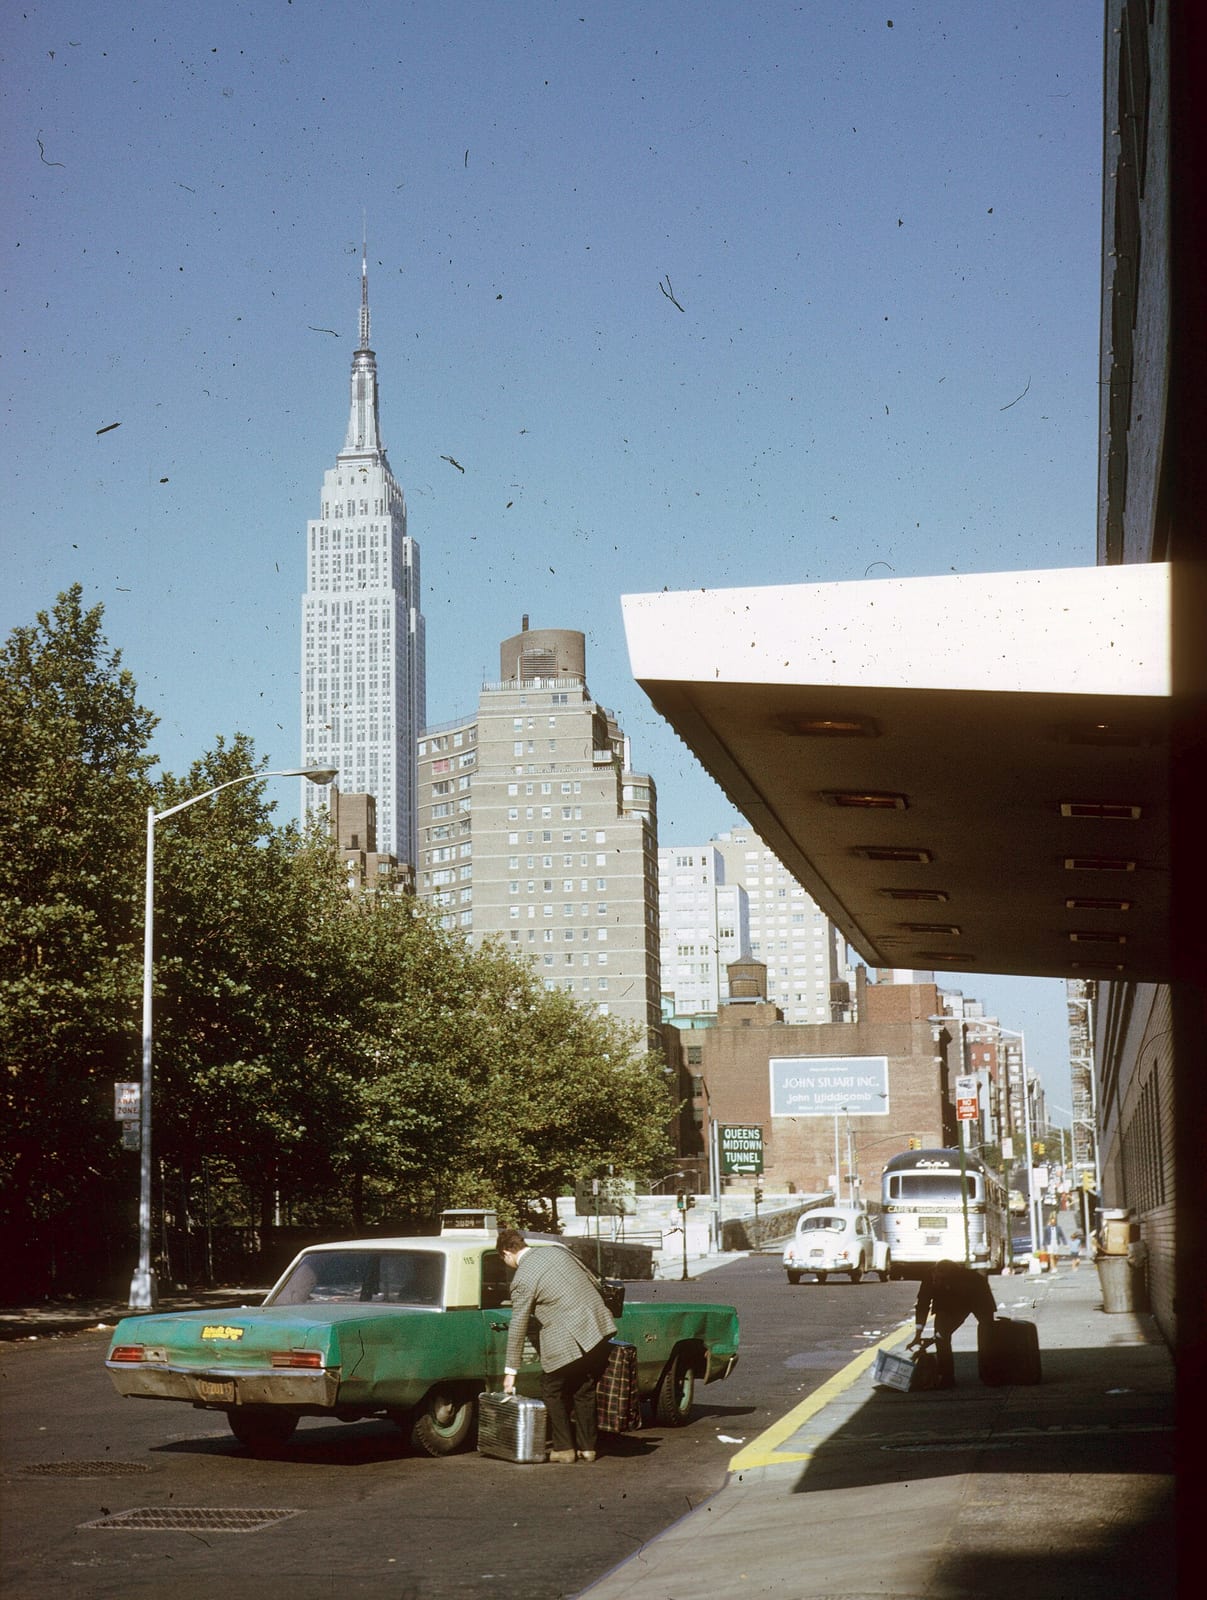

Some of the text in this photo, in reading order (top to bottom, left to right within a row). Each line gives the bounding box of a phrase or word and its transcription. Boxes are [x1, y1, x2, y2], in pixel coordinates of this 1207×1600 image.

[782, 1076, 879, 1089] JOHN STUART INC.
[814, 1092, 872, 1103] Widdicomb
[724, 1129, 760, 1139] QUEENS
[723, 1140, 762, 1150] MIDTOWN
[725, 1152, 761, 1163] TUNNEL
[463, 1256, 475, 1264] 115
